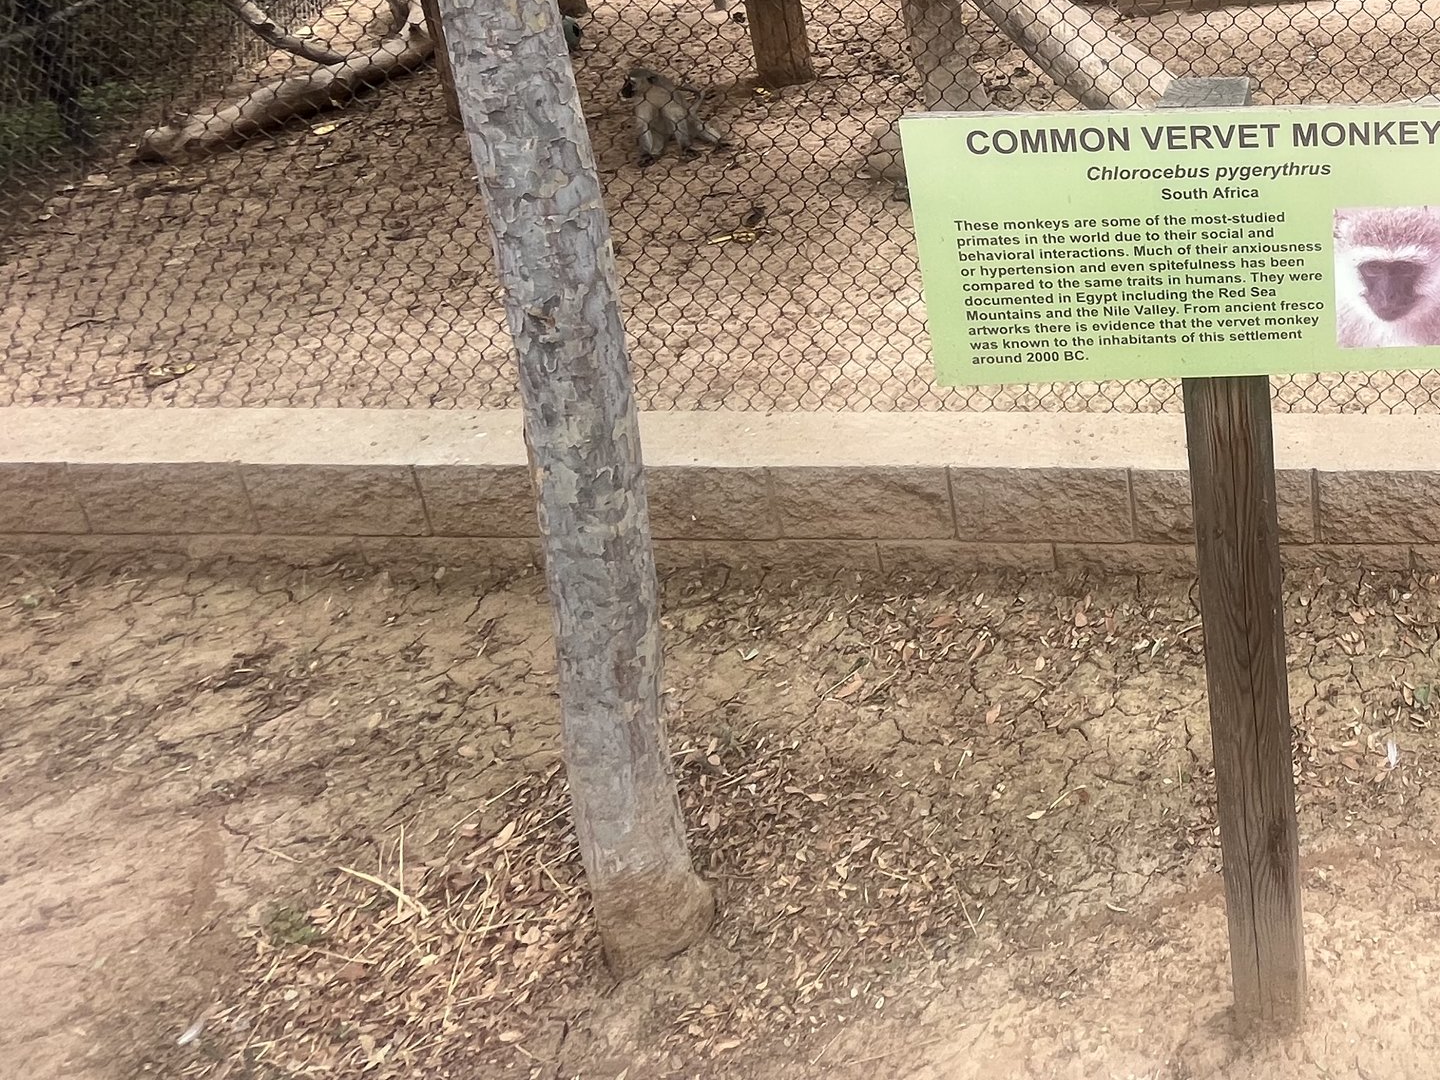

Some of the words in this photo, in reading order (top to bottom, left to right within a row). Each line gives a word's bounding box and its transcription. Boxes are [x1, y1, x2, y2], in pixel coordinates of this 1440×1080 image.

[966, 126, 1131, 155] COMMON
[1140, 123, 1281, 151] VERVET
[1087, 164, 1210, 181] Chlorocebus
[1215, 161, 1331, 182] pygerythrus
[1161, 187, 1208, 201] South
[1212, 186, 1259, 199] Africa
[953, 220, 999, 232] These
[1003, 218, 1070, 232] monkeys
[1074, 218, 1097, 229] are
[1101, 217, 1141, 228] some
[1145, 214, 1160, 226] of
[1163, 214, 1187, 226] the
[1190, 211, 1285, 225] most-studied
[956, 235, 1021, 250] primates
[1024, 235, 1038, 245] in
[1042, 233, 1066, 245] the
[1069, 231, 1110, 244] world
[1114, 230, 1142, 242] due
[1145, 231, 1160, 242] to
[1163, 229, 1198, 241] their
[1200, 227, 1244, 240] social
[1247, 226, 1275, 239] and
[958, 248, 1035, 262] behavioral
[1039, 246, 1130, 260] interactions.
[1133, 244, 1173, 257] Much
[1177, 243, 1192, 256] of
[1194, 243, 1229, 255] their
[1231, 242, 1322, 254] anxiousness
[960, 268, 976, 277] or
[979, 263, 1076, 279] hypertension
[1079, 261, 1107, 274] and
[1110, 263, 1145, 273] even
[1148, 258, 1236, 274] spitefulness
[1240, 257, 1266, 269] has
[1270, 256, 1305, 268] been
[962, 278, 1035, 293] compared
[1038, 279, 1054, 290] to
[1057, 277, 1080, 289] the
[1084, 278, 1123, 288] same
[1126, 275, 1164, 287] traits
[1167, 274, 1181, 286] in
[1185, 273, 1246, 285] humans.
[1249, 271, 1285, 285] They
[1288, 272, 1323, 282] were
[964, 292, 1054, 307] documented
[1058, 292, 1072, 304] in
[1075, 291, 1118, 306] Egypt
[1121, 289, 1188, 303] including
[1191, 288, 1215, 300] the
[1218, 287, 1246, 299] Red
[1250, 286, 1277, 298] Sea
[966, 308, 1042, 321] Mountains
[1045, 307, 1073, 319] and
[1075, 306, 1099, 318] the
[1103, 305, 1131, 317] Nile
[1133, 304, 1180, 318] Valley.
[1183, 303, 1221, 314] From
[1224, 301, 1277, 313] ancient
[1279, 300, 1325, 311] fresco
[968, 323, 1031, 336] artworks
[1034, 322, 1072, 334] there
[1075, 321, 1088, 332] is
[1091, 319, 1156, 332] evidence
[1158, 318, 1187, 330] that
[1190, 317, 1213, 329] the
[1216, 316, 1261, 328] vervet
[1264, 314, 1319, 327] monkey
[969, 341, 999, 351] was
[1002, 338, 1050, 349] known
[1053, 337, 1068, 348] to
[1071, 336, 1095, 347] the
[1098, 333, 1177, 346] inhabitants
[1181, 331, 1196, 343] of
[1198, 331, 1225, 343] this
[1229, 329, 1303, 342] settlement
[972, 352, 1023, 365] around
[1026, 351, 1060, 363] 2000
[1063, 350, 1089, 362] BC.
